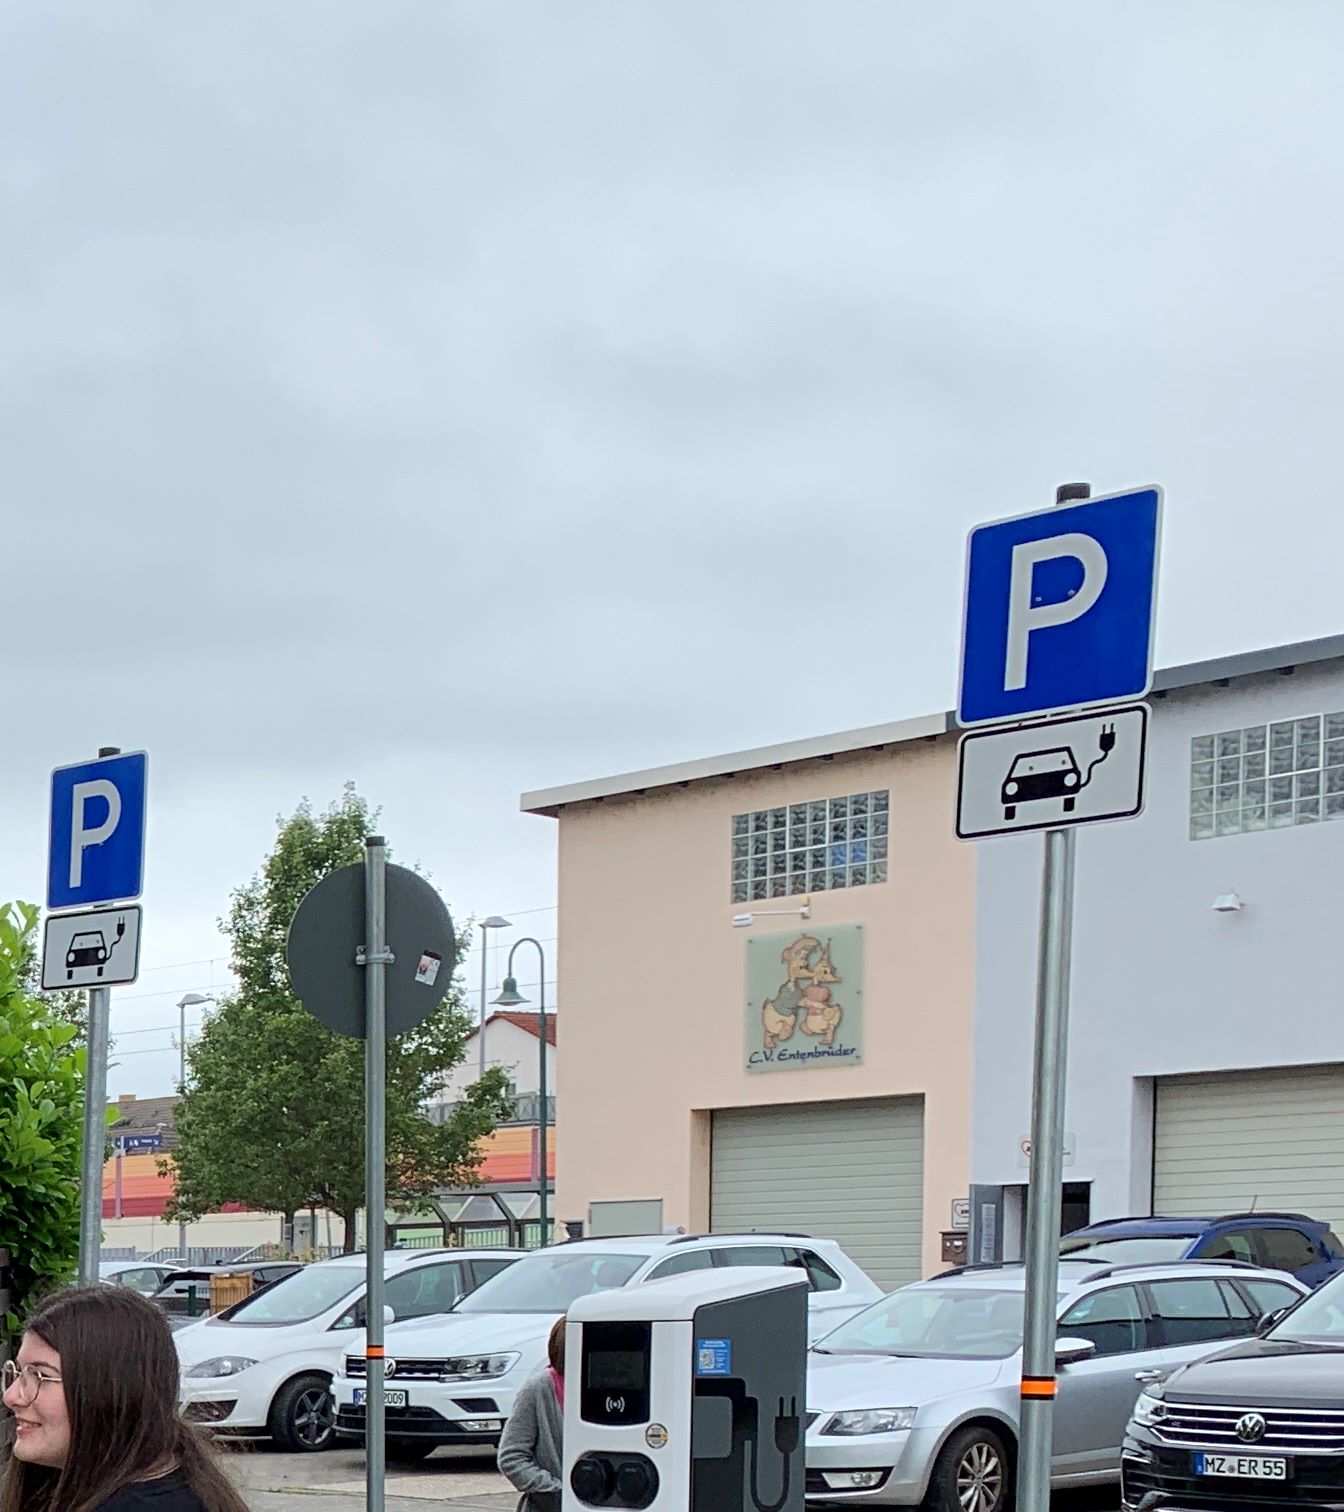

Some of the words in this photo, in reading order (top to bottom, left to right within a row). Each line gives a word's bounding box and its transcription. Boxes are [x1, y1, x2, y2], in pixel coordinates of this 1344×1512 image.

[1004, 533, 1108, 692] P
[69, 779, 122, 889] P
[777, 1043, 856, 1062] Entenbrüder
[1204, 1457, 1226, 1474] MZ
[1237, 1458, 1259, 1475] ER
[1262, 1460, 1285, 1477] 55
